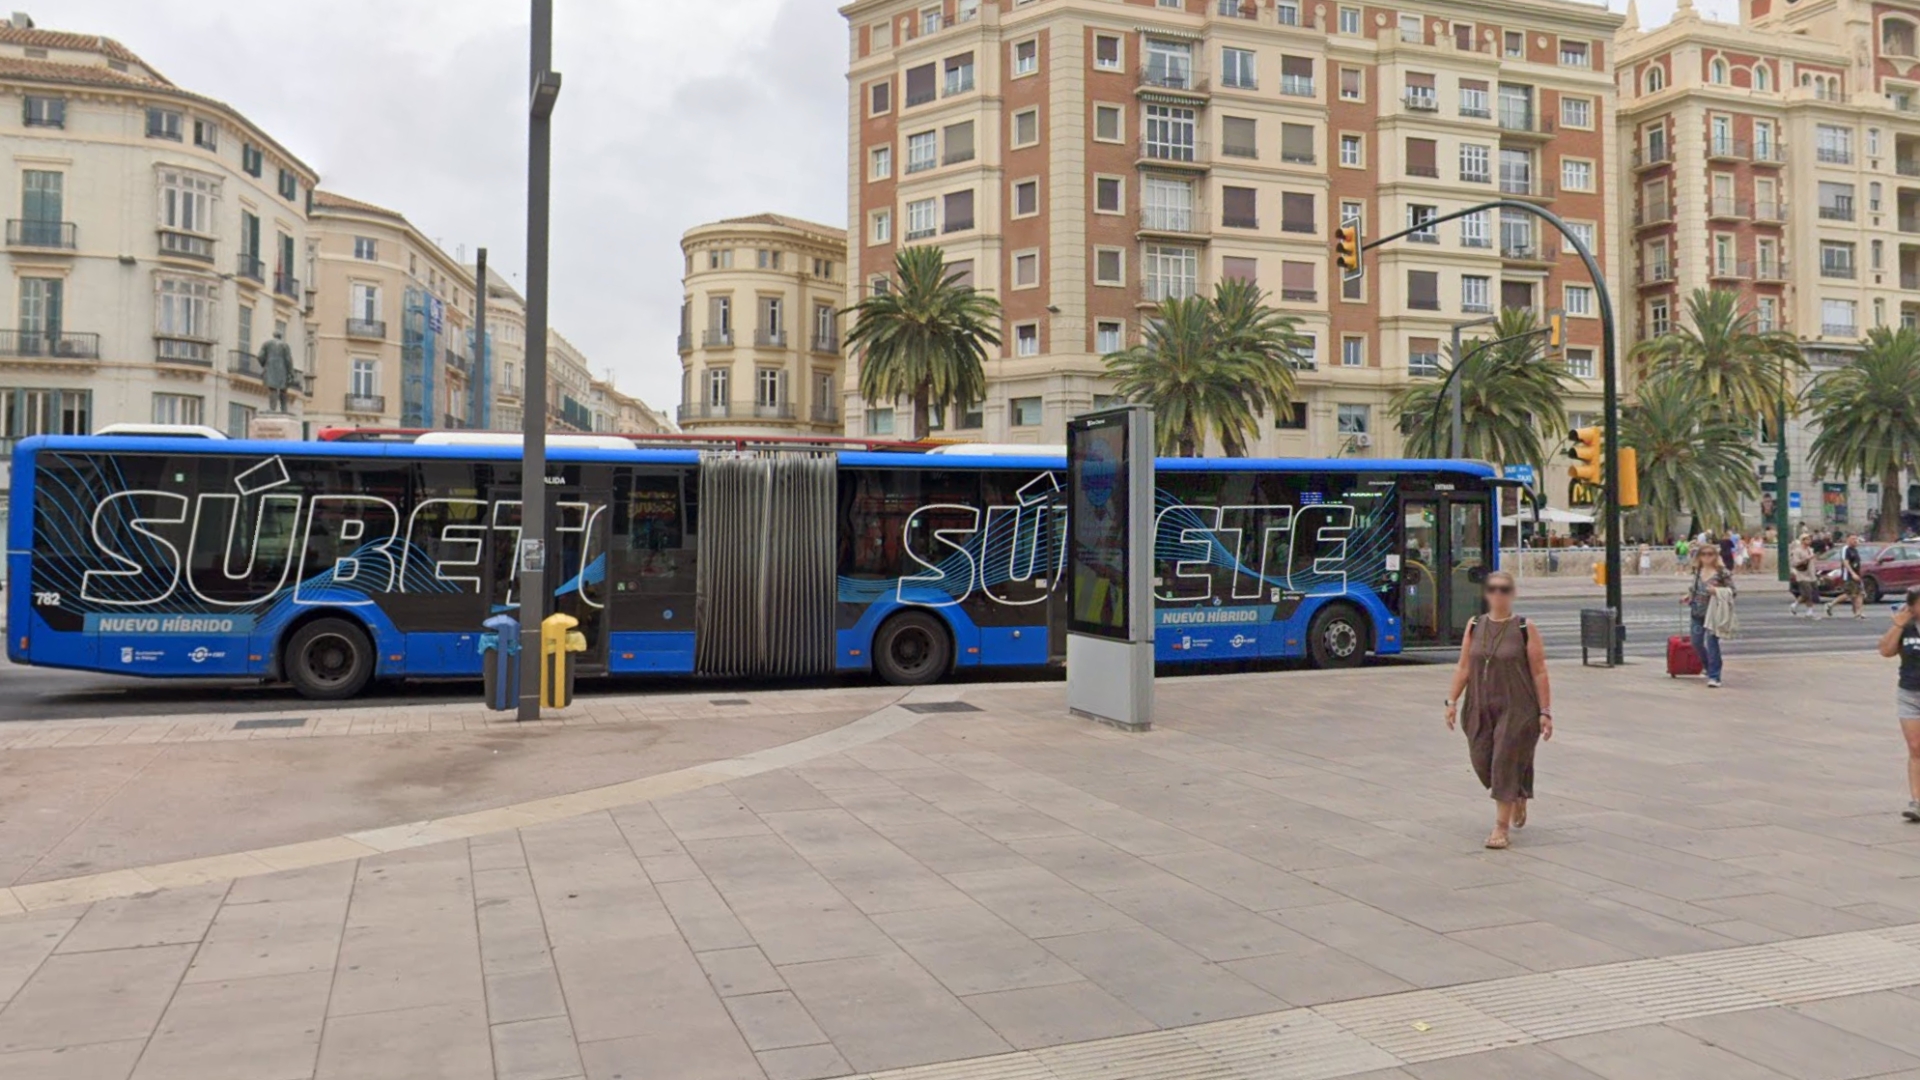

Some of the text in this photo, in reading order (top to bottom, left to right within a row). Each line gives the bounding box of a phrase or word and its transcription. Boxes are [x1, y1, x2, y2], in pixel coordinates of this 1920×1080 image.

[35, 592, 60, 605] 782
[100, 615, 233, 632] NUEVO HÍBRIDO
[1162, 608, 1258, 624] NUEVO HÍBRIDO
